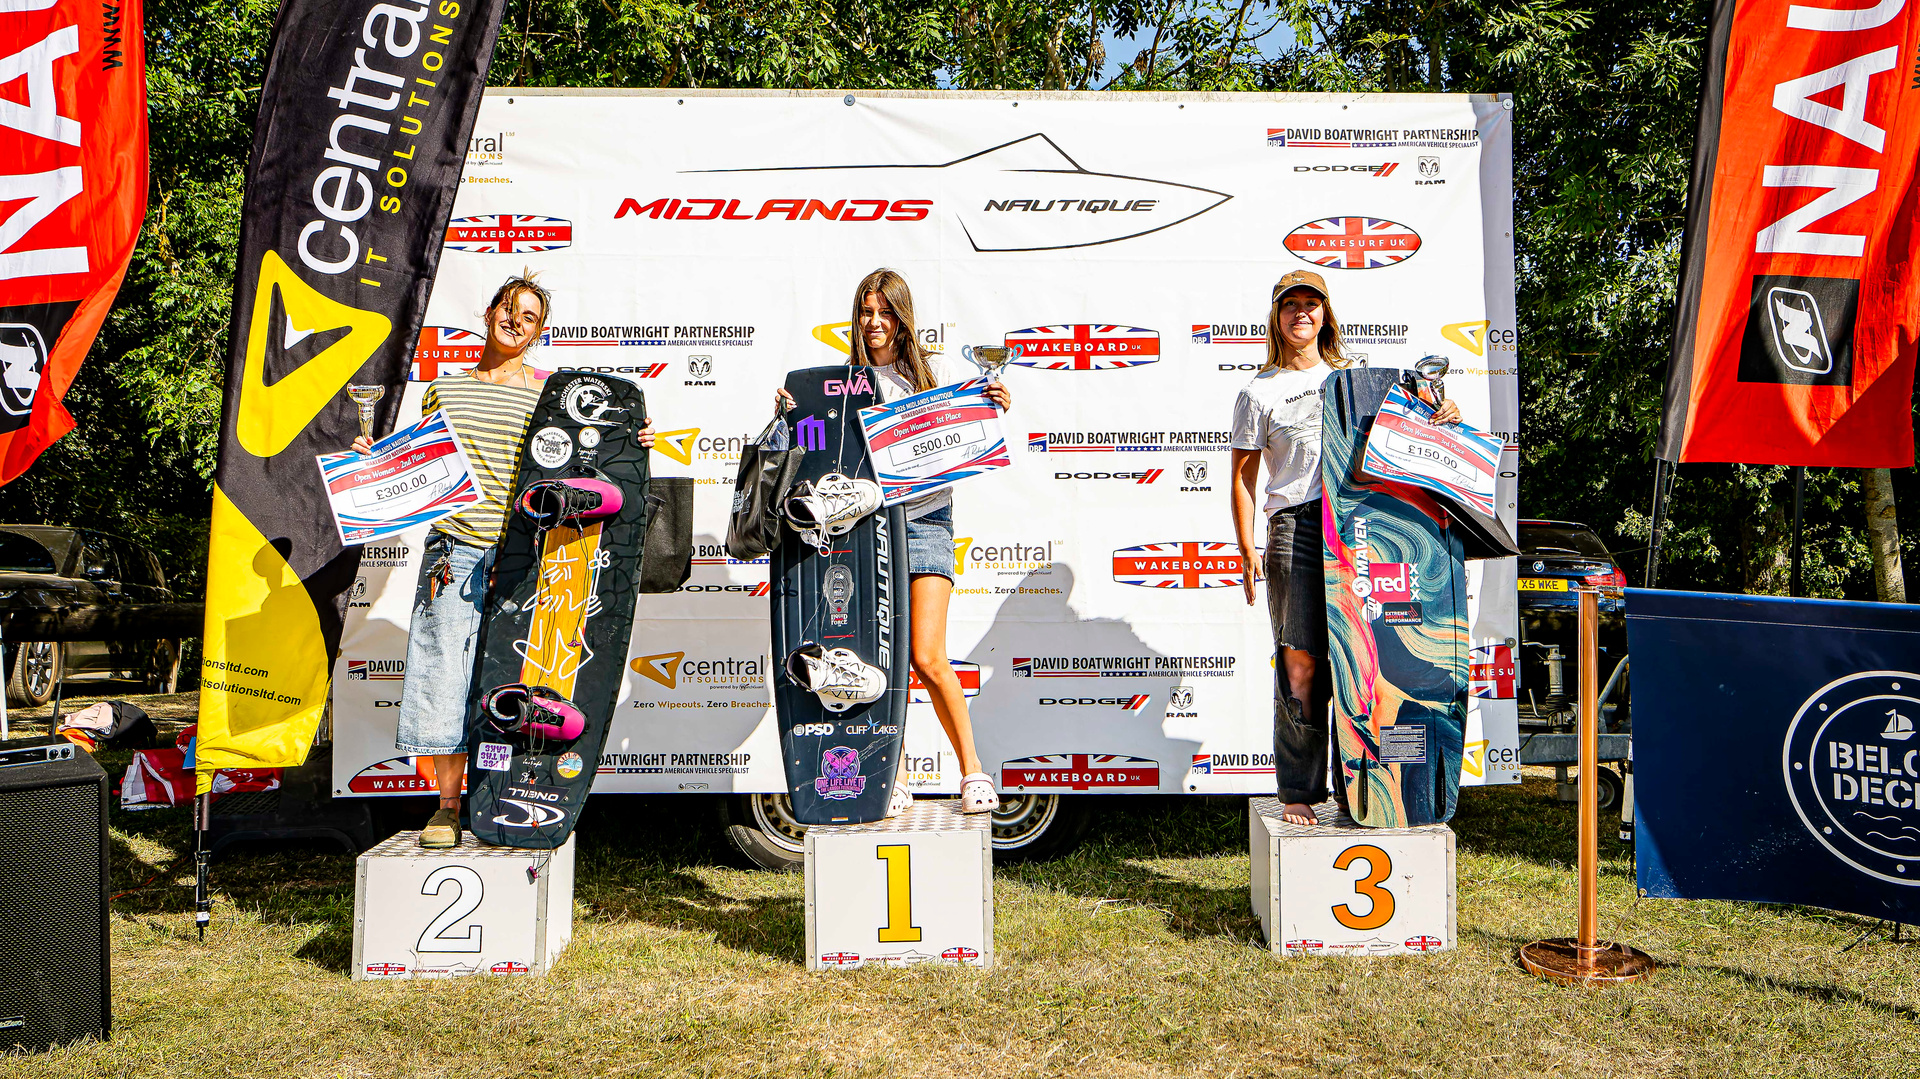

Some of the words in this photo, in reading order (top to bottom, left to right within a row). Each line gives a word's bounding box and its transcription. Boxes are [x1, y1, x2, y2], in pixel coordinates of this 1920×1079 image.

[0, 0, 90, 283] NA
[297, 0, 431, 274] centra
[1287, 128, 1321, 140] DAVID
[1324, 128, 1399, 141] BOATWRIGHT
[1403, 128, 1479, 142] PARTNERSHIP
[360, 247, 388, 287] IT
[379, 0, 460, 214] SOLUTIONS
[468, 176, 513, 184] Breaches.
[613, 198, 934, 222] MIDLANDS
[984, 199, 1158, 213] NAUTIQUE
[458, 230, 545, 238] WAKEBOARD
[1306, 238, 1384, 247] WAKESURF
[1390, 238, 1406, 247] UK
[552, 326, 588, 339] DAVID
[591, 326, 670, 339] BOATWRIGHT
[674, 326, 755, 339] PARTNERSHIP
[1212, 324, 1248, 336] DAVID
[1339, 324, 1409, 337] ARTNERSHIP
[414, 350, 461, 359] ESURF
[465, 350, 481, 359] UK
[1026, 343, 1129, 352] WAKEBOARD
[1466, 368, 1509, 377] Wipeouts.
[560, 377, 583, 410] CHICHESTER
[583, 376, 613, 397] WATERSKI
[824, 377, 874, 396] GWA
[905, 397, 930, 411] MIDLANDS
[929, 391, 954, 404] NAUTIQUE
[926, 401, 951, 412] NATIONALS
[893, 427, 909, 438] Open
[909, 421, 932, 432] Women
[936, 416, 945, 425] 1st
[945, 412, 962, 422] Place
[912, 433, 961, 456] £500.00
[1048, 433, 1085, 444] DAVID
[1087, 432, 1165, 444] BOATWRIGHT
[1170, 432, 1233, 444] PARTNERS
[1400, 420, 1414, 433] Open
[1414, 425, 1436, 441] Women
[1440, 437, 1451, 449] 3rd
[1450, 441, 1465, 455] Place
[1407, 444, 1458, 469] £150.00
[354, 471, 372, 483] Open
[372, 466, 396, 479] Women
[400, 458, 412, 469] 2nd
[411, 451, 426, 465] Place
[1055, 472, 1148, 480] DODGE
[375, 474, 427, 500] £300.00
[361, 547, 409, 559] NERSHIP
[971, 541, 1052, 562] central
[1354, 516, 1369, 576] MAVEN
[1134, 561, 1236, 570] WAKEBOARD
[1374, 563, 1406, 593] red
[1521, 580, 1536, 589] X5
[1538, 580, 1559, 590] WKE
[875, 514, 890, 670] NAUTIQUE
[1018, 586, 1063, 595] Breaches.
[201, 657, 269, 678] ionsltd.com
[369, 660, 404, 673] DAVID
[682, 655, 764, 676] central
[1033, 657, 1069, 670] DAVID
[1072, 657, 1150, 670] BOATWRIGHT
[1155, 656, 1236, 669] PARTNERSHIP
[1470, 668, 1514, 677] AKESU
[200, 678, 302, 706] itsolutionsltd.com
[657, 701, 704, 710] Wipeouts.
[805, 723, 834, 736] PSD
[845, 725, 868, 735] CLIFF
[872, 725, 898, 735] LAKES
[599, 753, 666, 765] OATWRIGHT
[671, 753, 751, 766] PARTNERSHIP
[1212, 754, 1249, 766] DAVID
[830, 778, 843, 787] LIFE
[843, 778, 857, 787] LIVE
[1024, 772, 1127, 782] WAKEBOARD
[373, 780, 437, 789] WAKESU
[1833, 773, 1920, 810] DEC
[508, 787, 559, 802] O'NEILL
[877, 844, 922, 943] 1
[1331, 844, 1396, 930] 3
[415, 864, 485, 953] 2
